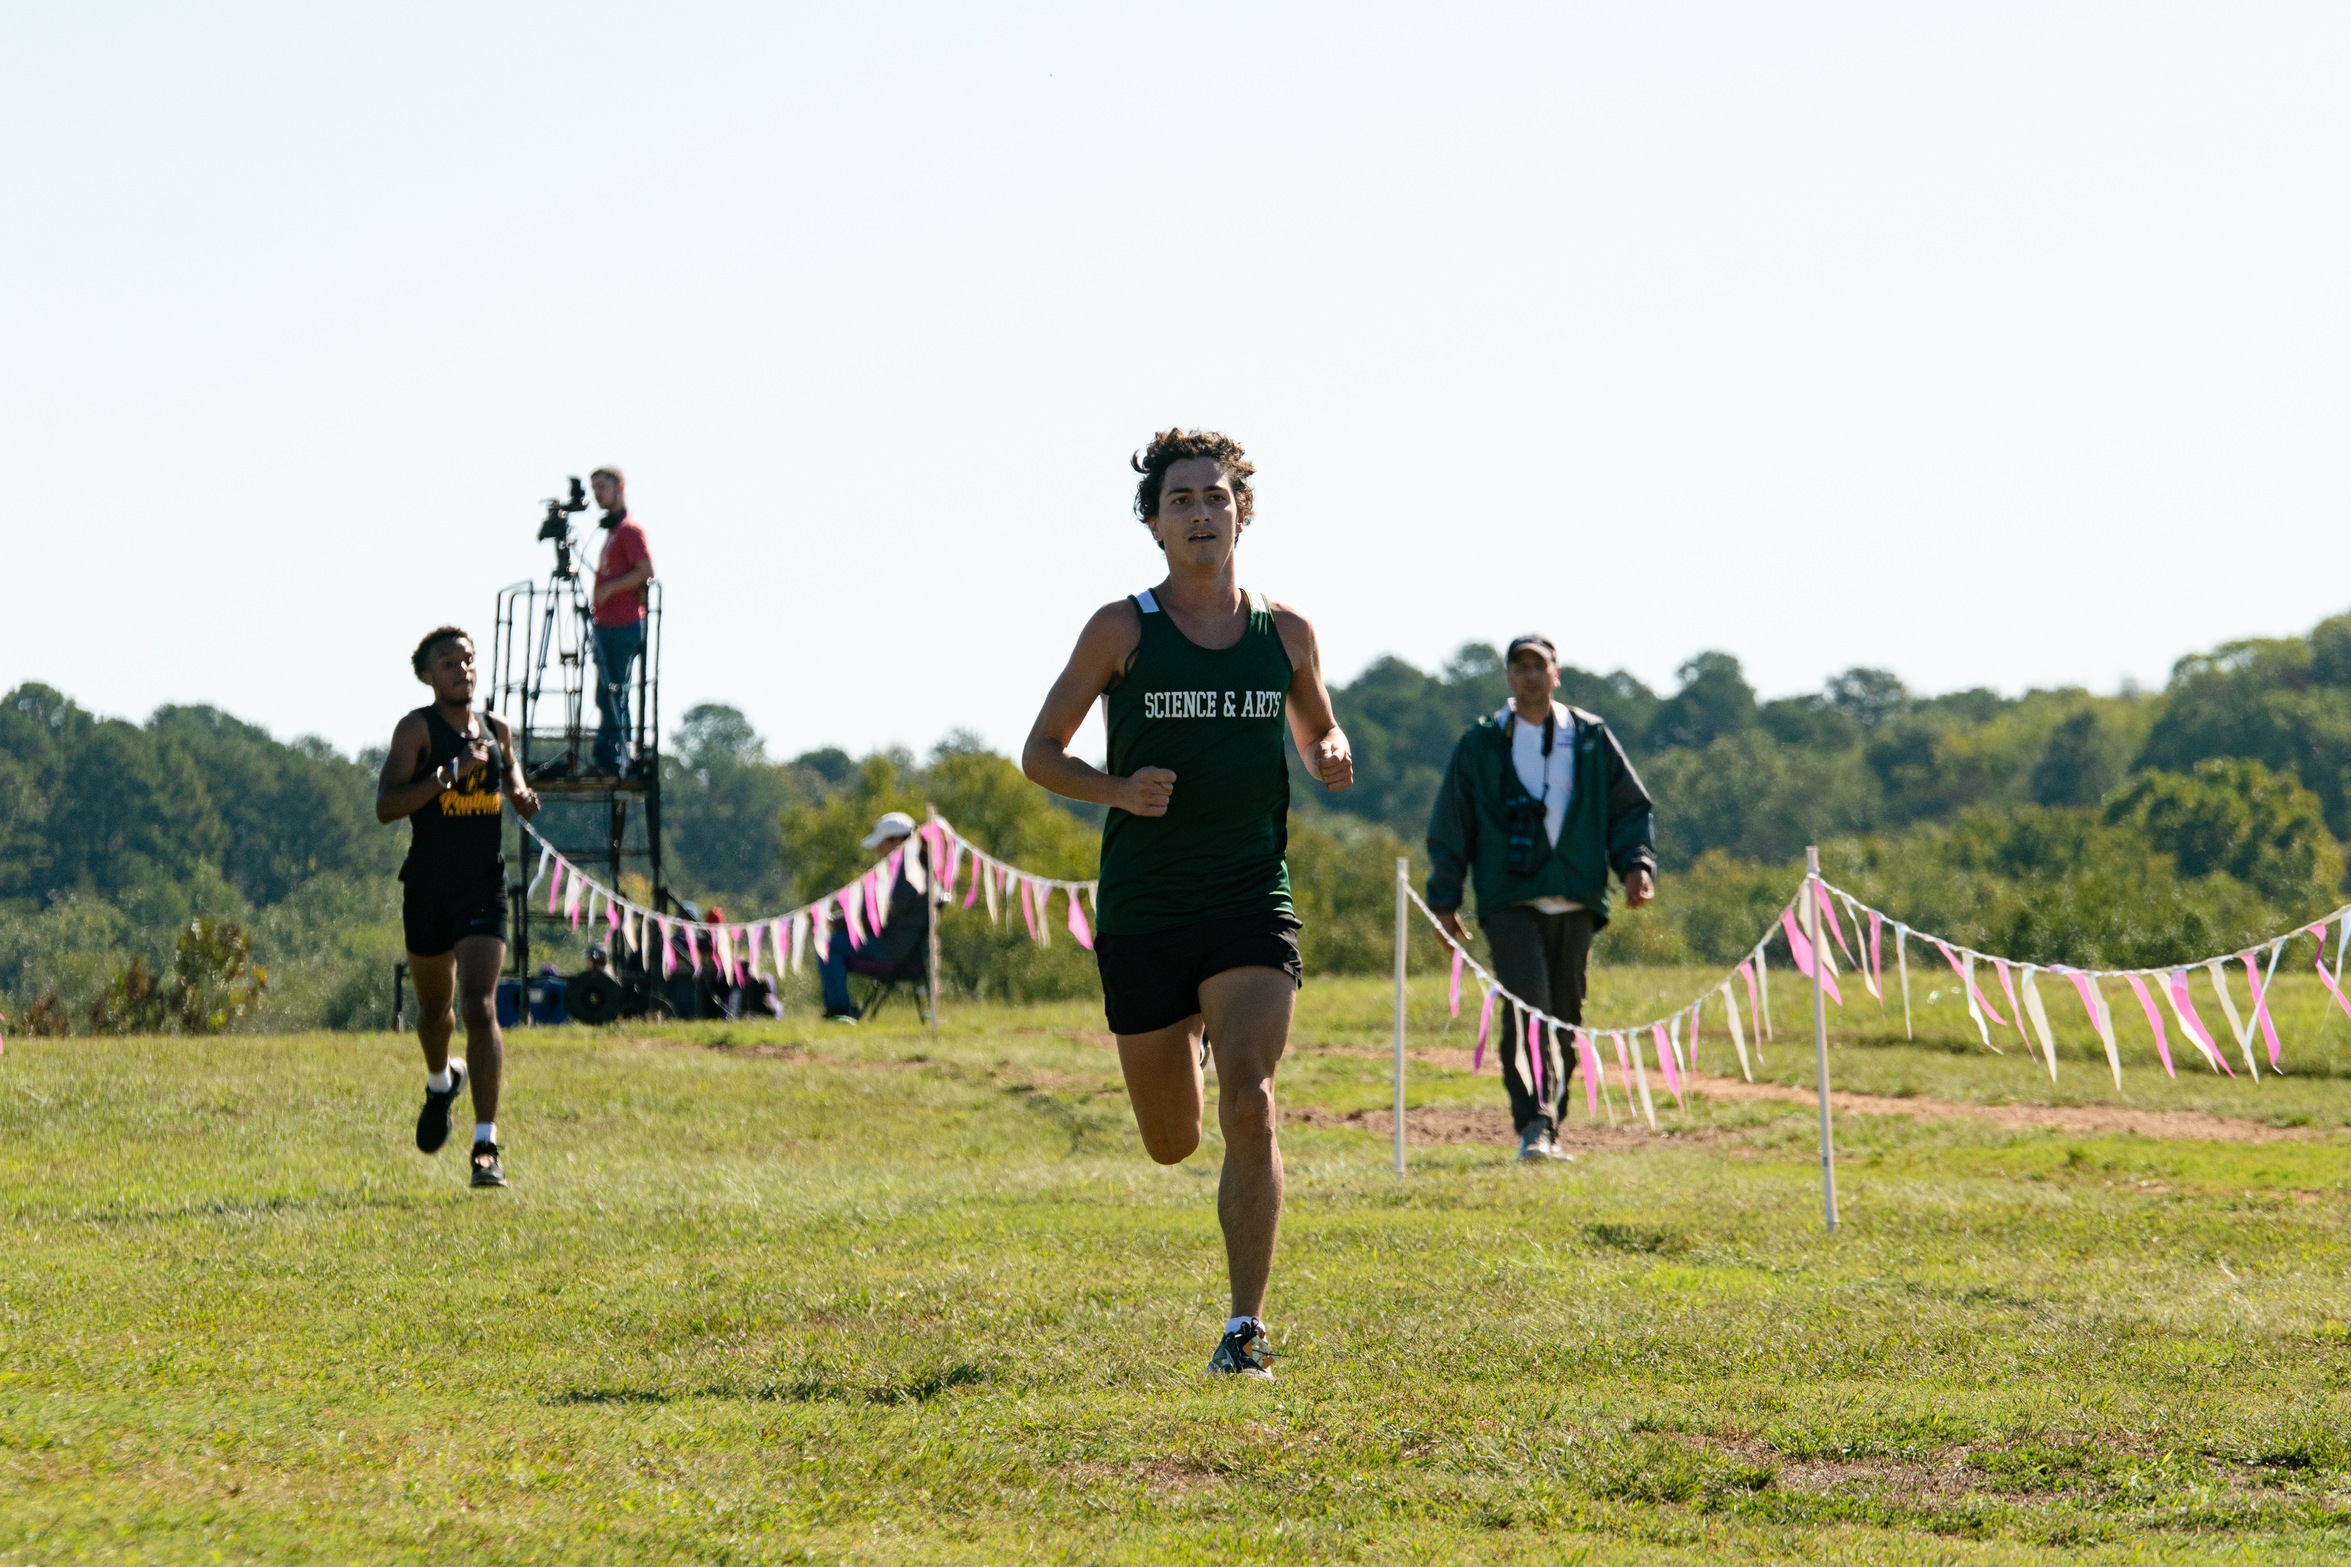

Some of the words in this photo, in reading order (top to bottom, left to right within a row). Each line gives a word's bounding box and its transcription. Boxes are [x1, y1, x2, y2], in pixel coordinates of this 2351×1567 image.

[1144, 691, 1217, 719] SCIENCE
[1223, 690, 1236, 718] &
[1240, 690, 1282, 718] ARTS
